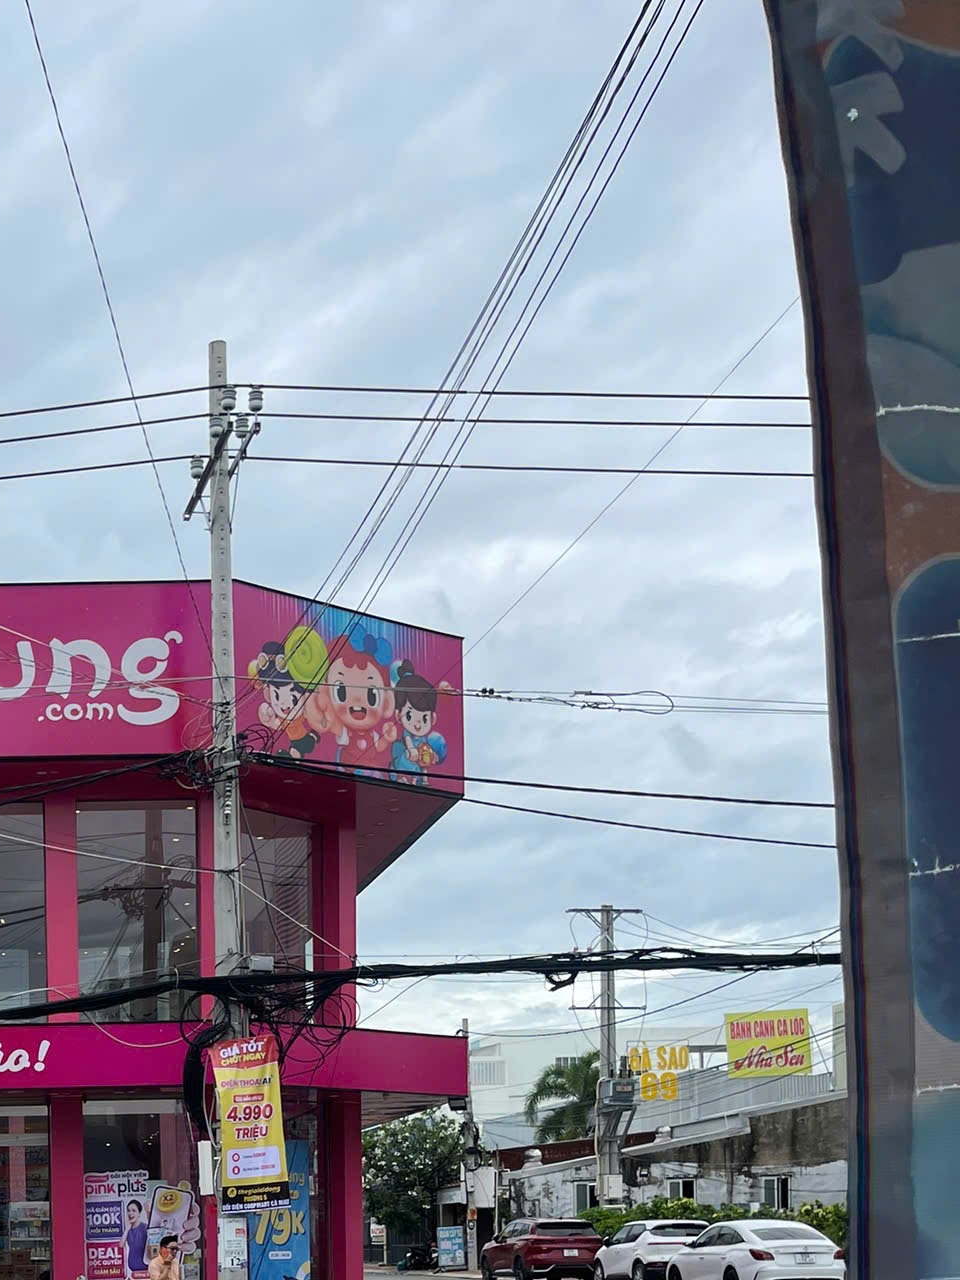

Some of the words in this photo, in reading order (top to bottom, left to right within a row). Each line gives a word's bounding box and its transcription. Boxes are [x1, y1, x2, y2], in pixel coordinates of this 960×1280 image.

[37, 701, 115, 722] .com
[753, 1019, 775, 1038] CANH
[220, 1043, 240, 1058] GIÁ
[241, 1037, 265, 1053] TỐT
[656, 1046, 689, 1070] SAO
[640, 1072, 678, 1101] 69
[226, 1103, 273, 1122] 4.990
[235, 1123, 269, 1141] TRIỆU
[85, 1182, 116, 1199] pink
[118, 1179, 147, 1197] plus
[87, 1213, 121, 1225] 100K
[88, 1247, 122, 1259] DEAL
